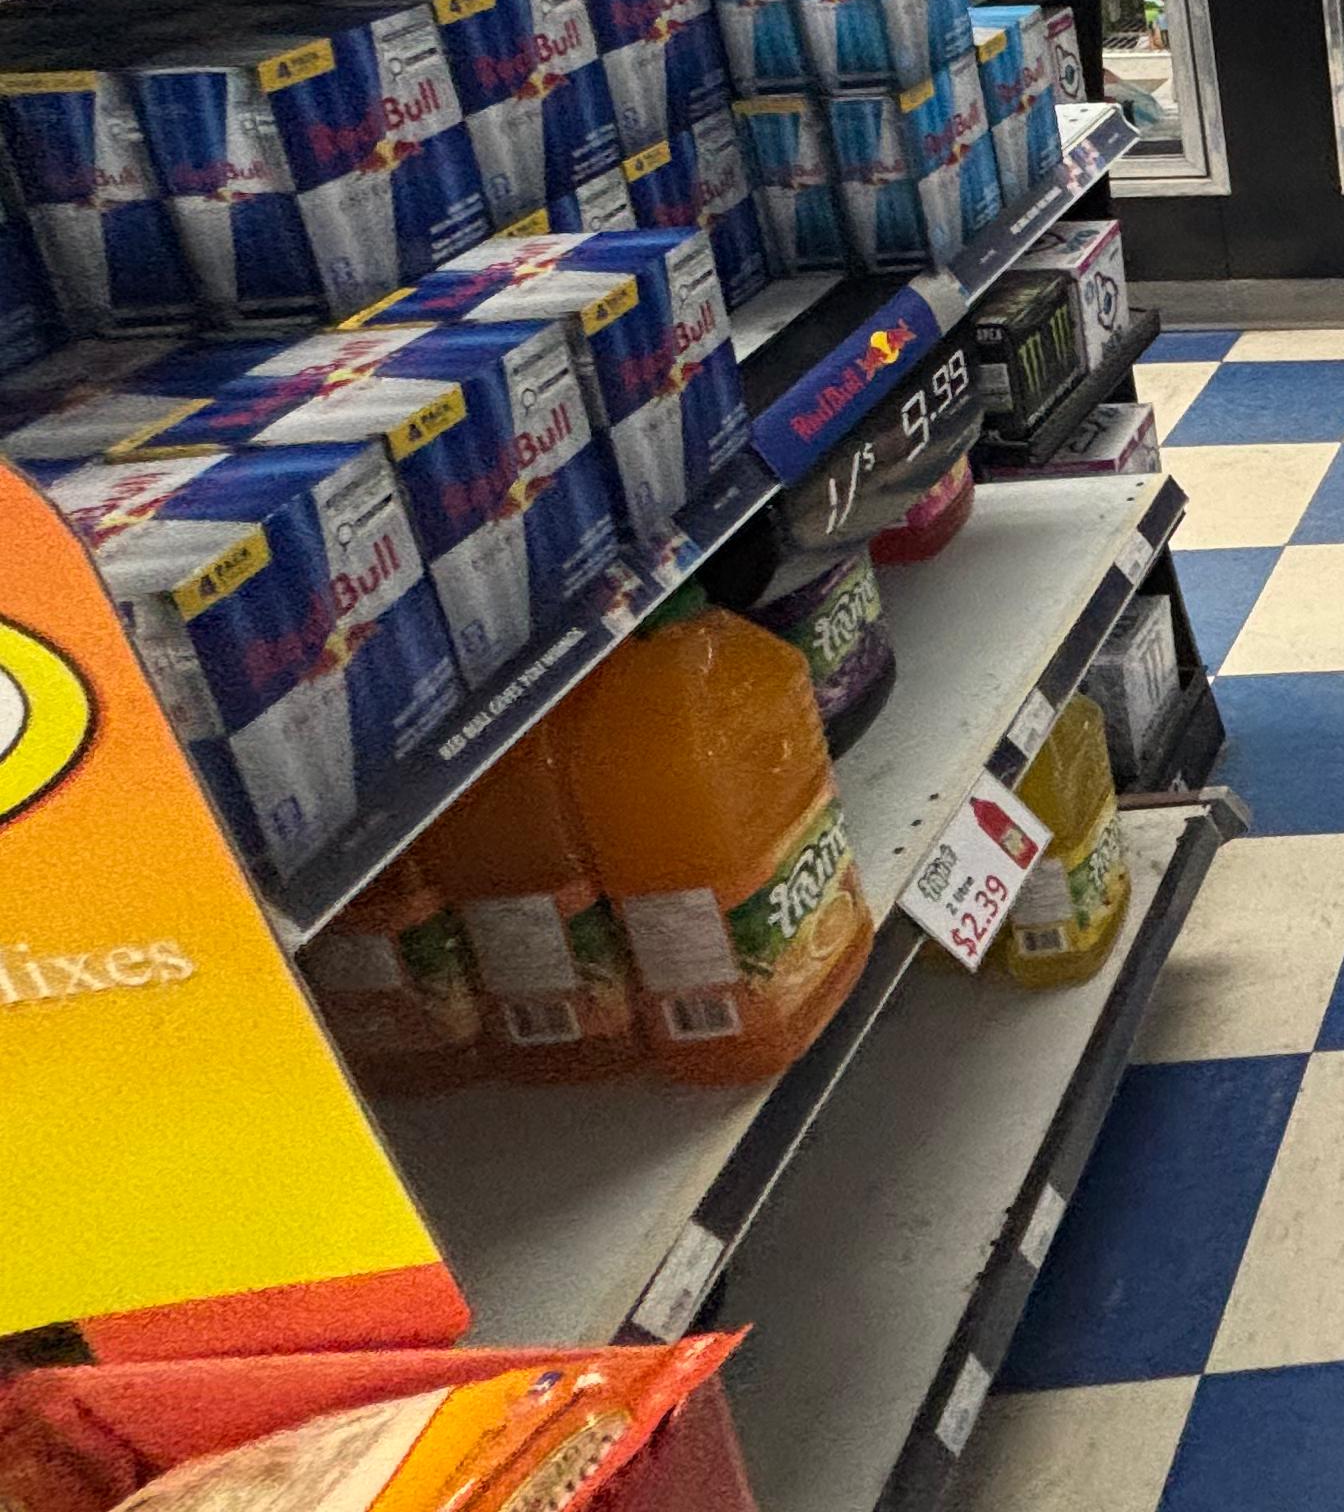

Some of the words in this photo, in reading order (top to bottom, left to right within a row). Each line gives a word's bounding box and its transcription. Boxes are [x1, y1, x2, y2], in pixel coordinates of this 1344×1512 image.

[534, 18, 583, 63] Bull
[382, 77, 442, 130] Bull
[673, 300, 715, 355] Bull
[420, 401, 455, 431] PACK
[901, 349, 969, 463] 9.99
[515, 403, 573, 468] Bull
[214, 547, 252, 581] PACK
[330, 533, 401, 618] Bull
[951, 874, 1009, 958] $2.39
[952, 875, 976, 903] litre
